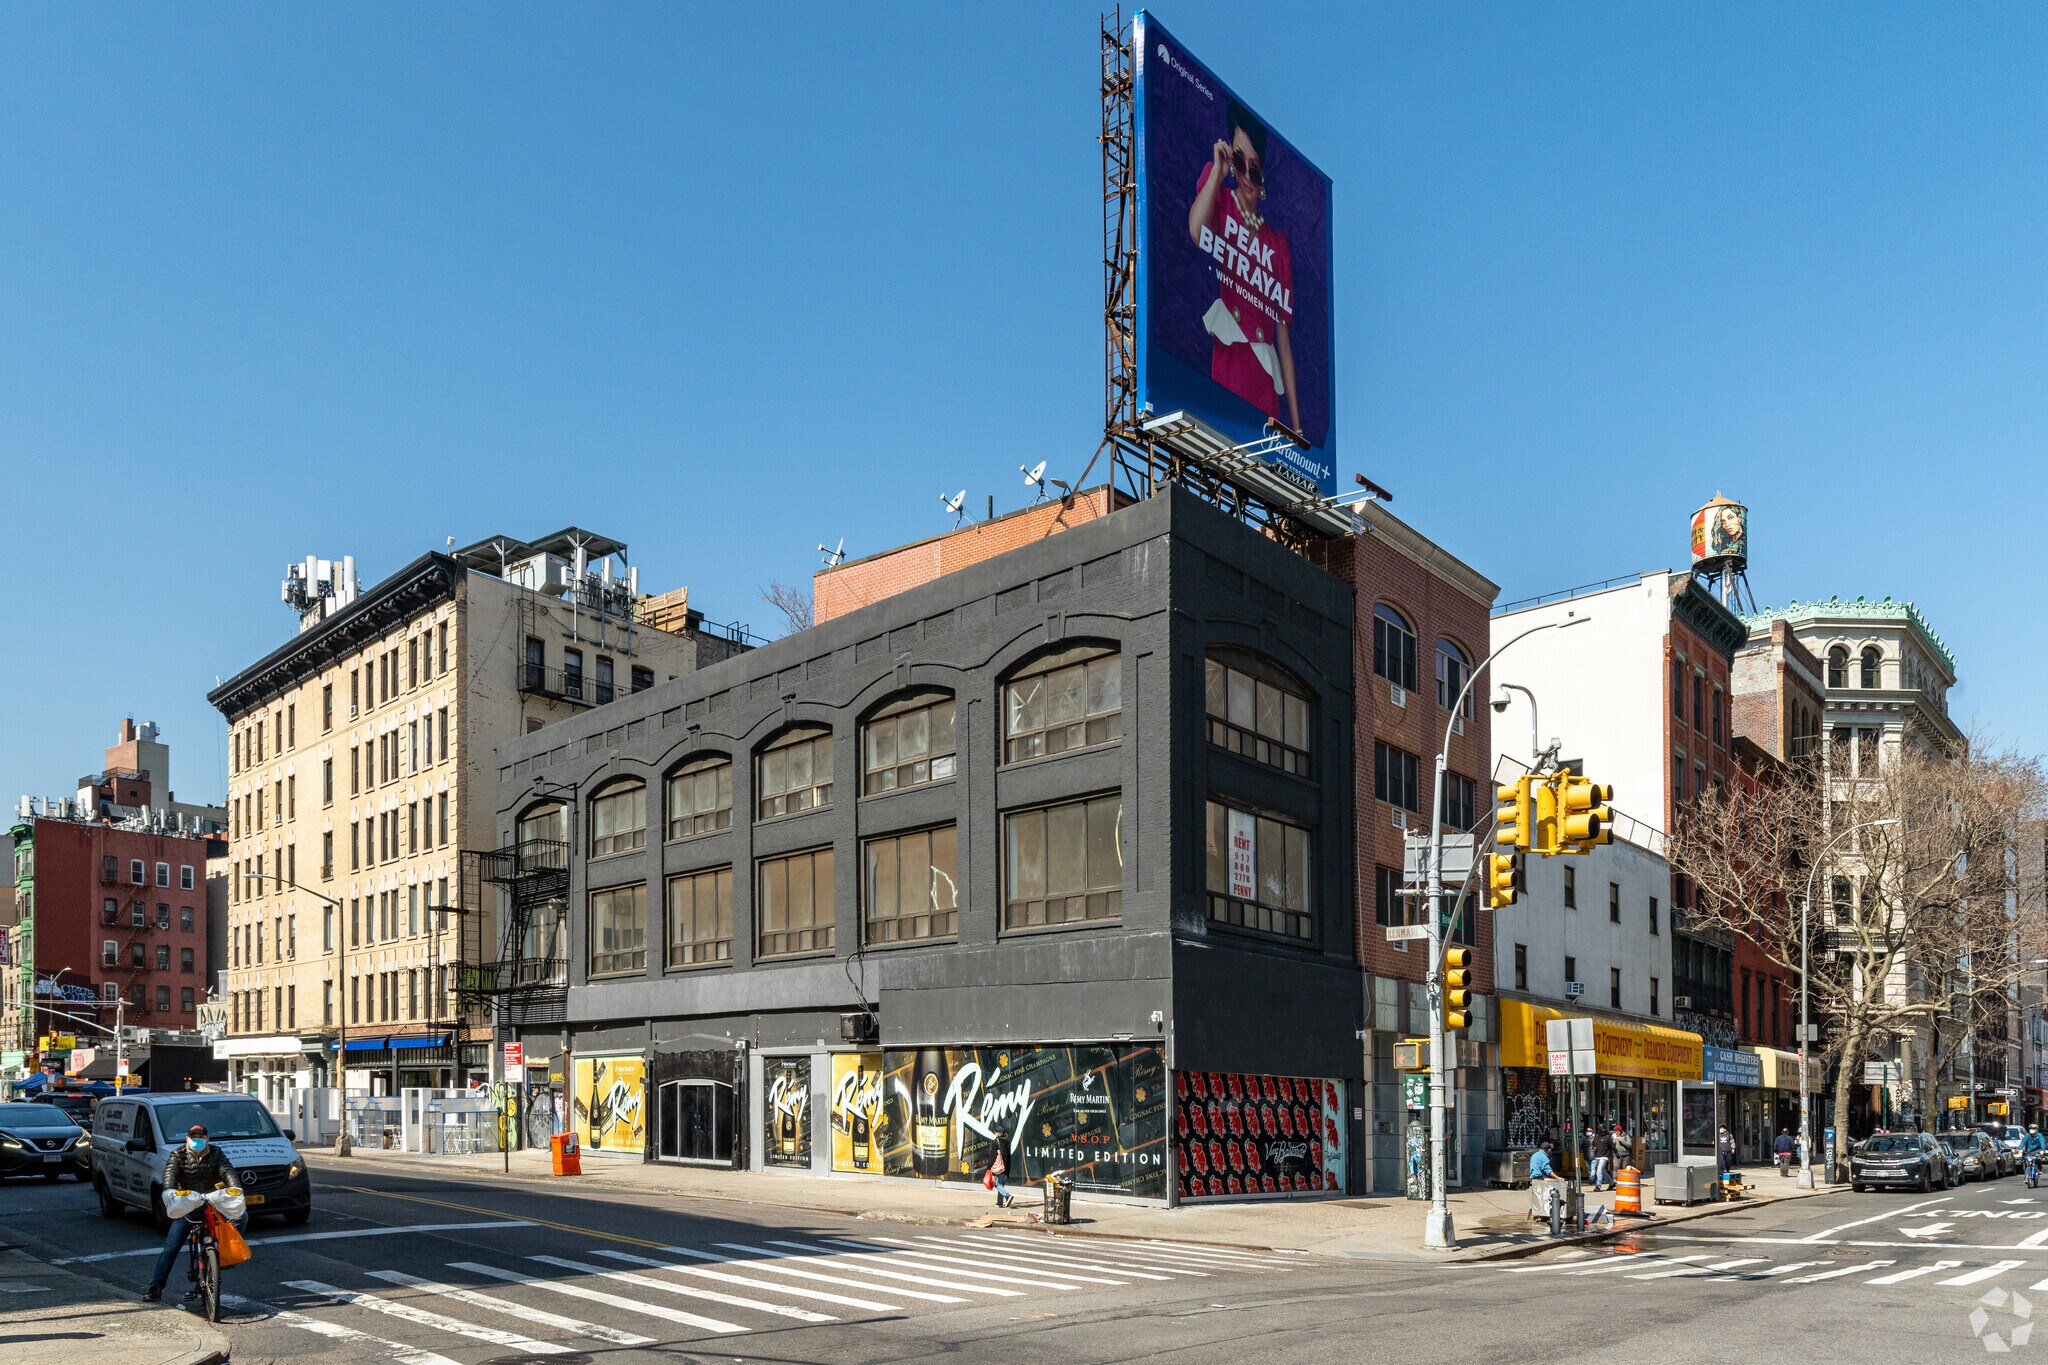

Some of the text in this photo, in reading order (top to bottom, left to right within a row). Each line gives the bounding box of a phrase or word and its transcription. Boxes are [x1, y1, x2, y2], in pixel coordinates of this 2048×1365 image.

[1171, 57, 1214, 100] Original Series
[1224, 214, 1275, 273] PEAK
[1199, 224, 1293, 315] BETRAYAL
[1216, 268, 1280, 323] WHY WOMEN KILL
[1278, 466, 1315, 492] LAMAR
[1233, 836, 1250, 851] RENT
[1234, 872, 1250, 884] 2778
[1233, 884, 1252, 898] PENNY
[1025, 1053, 1057, 1071] CHAMPAGNE
[1720, 1050, 1734, 1061] CASH
[1734, 1053, 1760, 1065] REGISTERS
[608, 1076, 642, 1133] Rémy
[768, 1076, 809, 1125] Rémy
[835, 1070, 883, 1131] Rémy
[1085, 1093, 1110, 1104] MARTIN
[943, 1062, 1036, 1161] Rémy
[1128, 1107, 1153, 1121] COGNAC
[835, 1160, 860, 1168] LIMITED
[1026, 1146, 1161, 1165] LIMITED EDITION
[1902, 1209, 2048, 1219] ONLY
